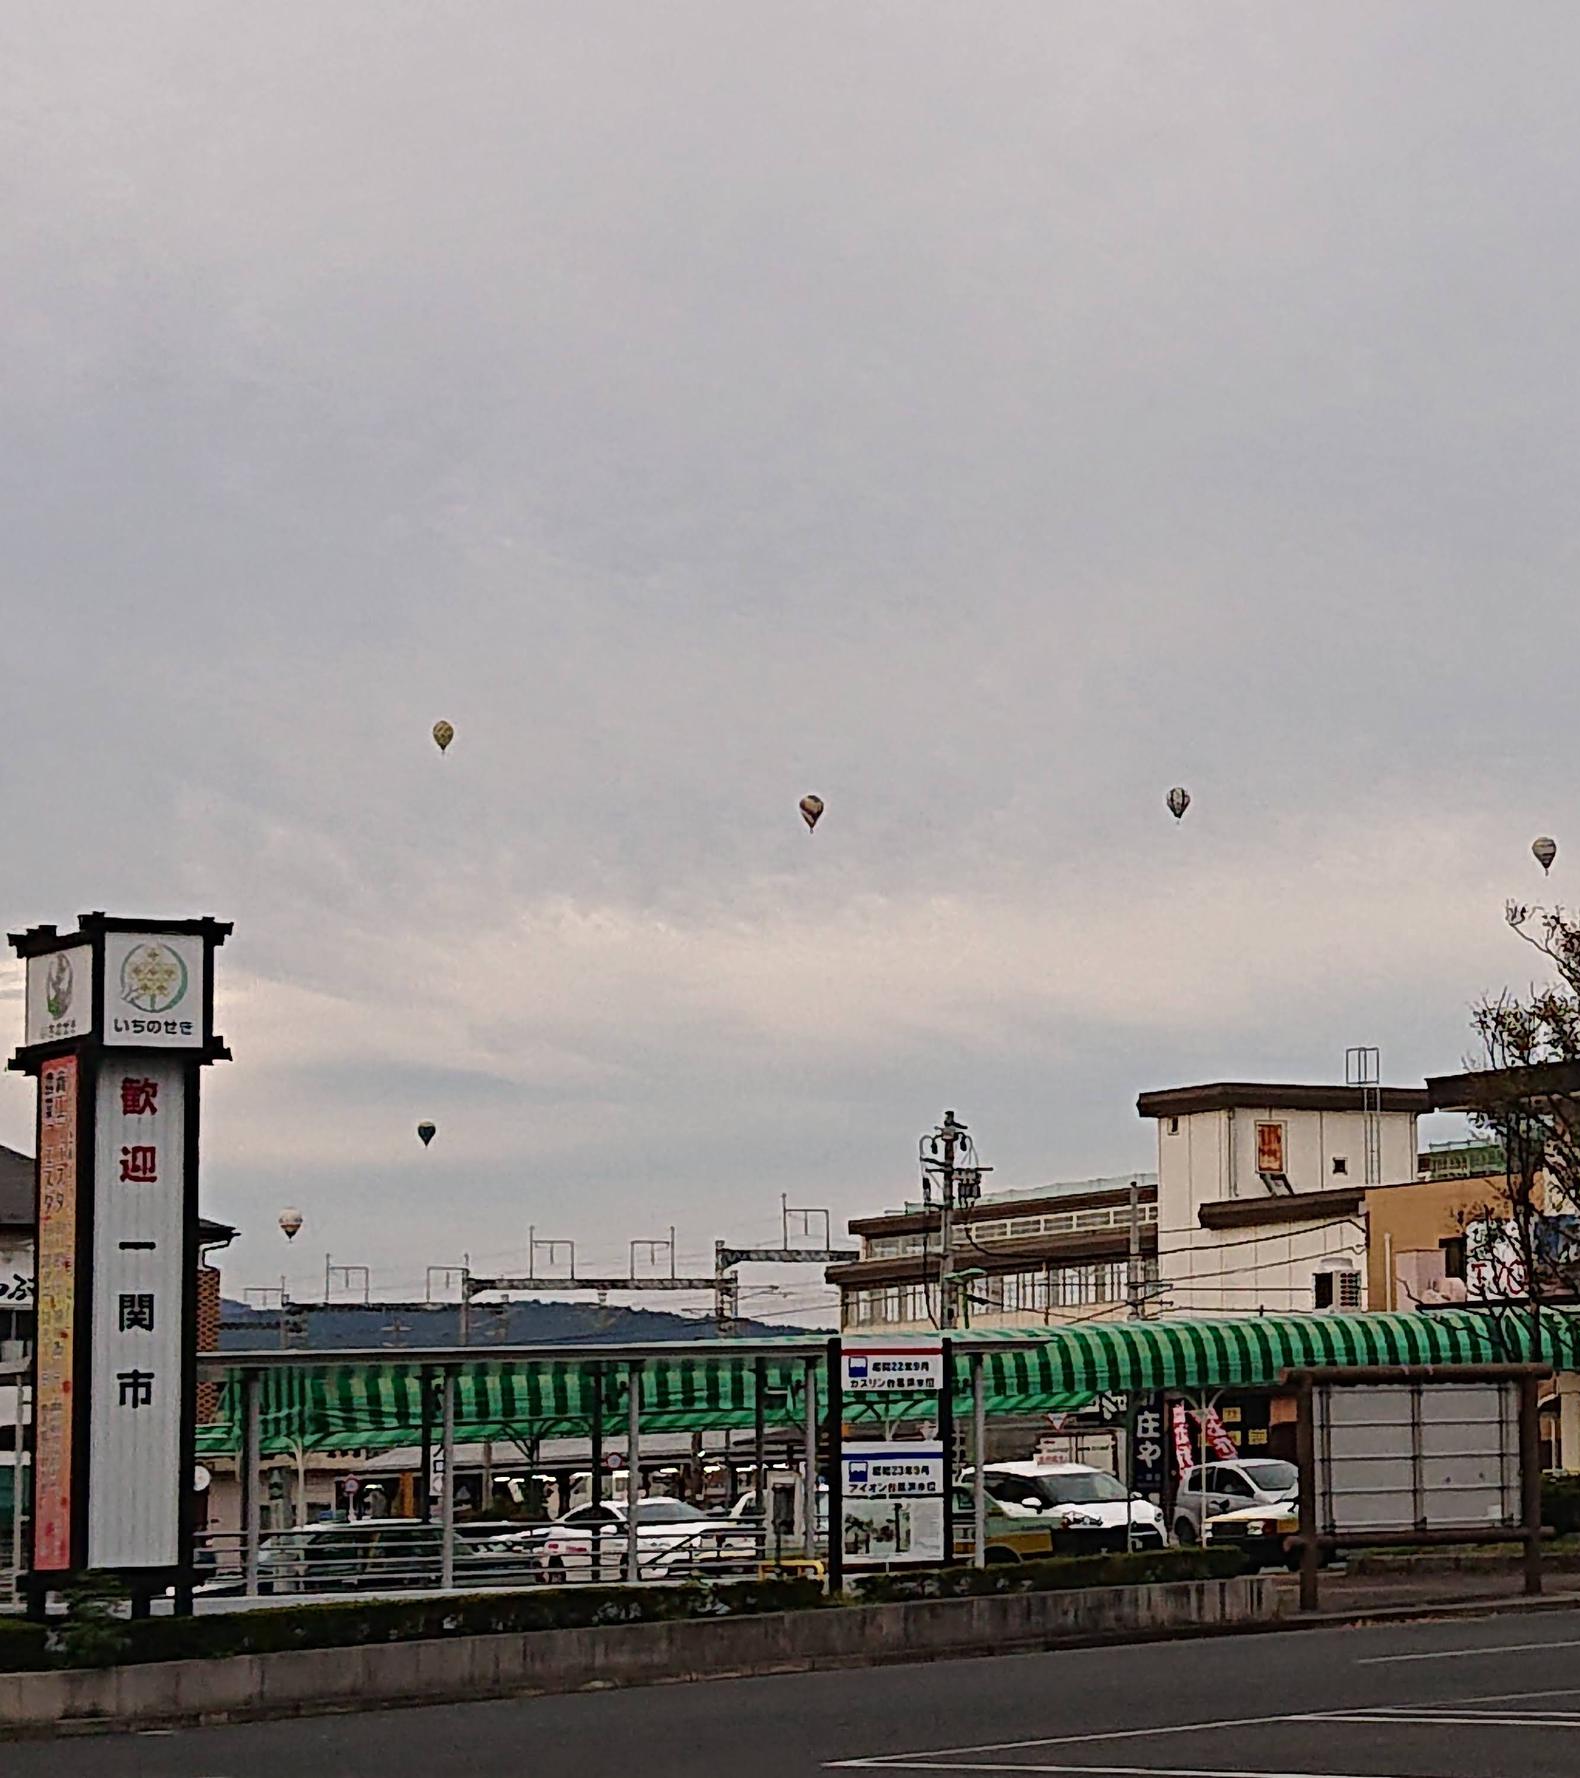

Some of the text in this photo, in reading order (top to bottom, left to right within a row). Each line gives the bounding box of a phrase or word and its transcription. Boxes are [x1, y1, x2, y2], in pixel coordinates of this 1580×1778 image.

[114, 1018, 193, 1036] いちのせき
[116, 1077, 158, 1409] 歓迎 一関市
[1136, 1410, 1162, 1469] 庄や
